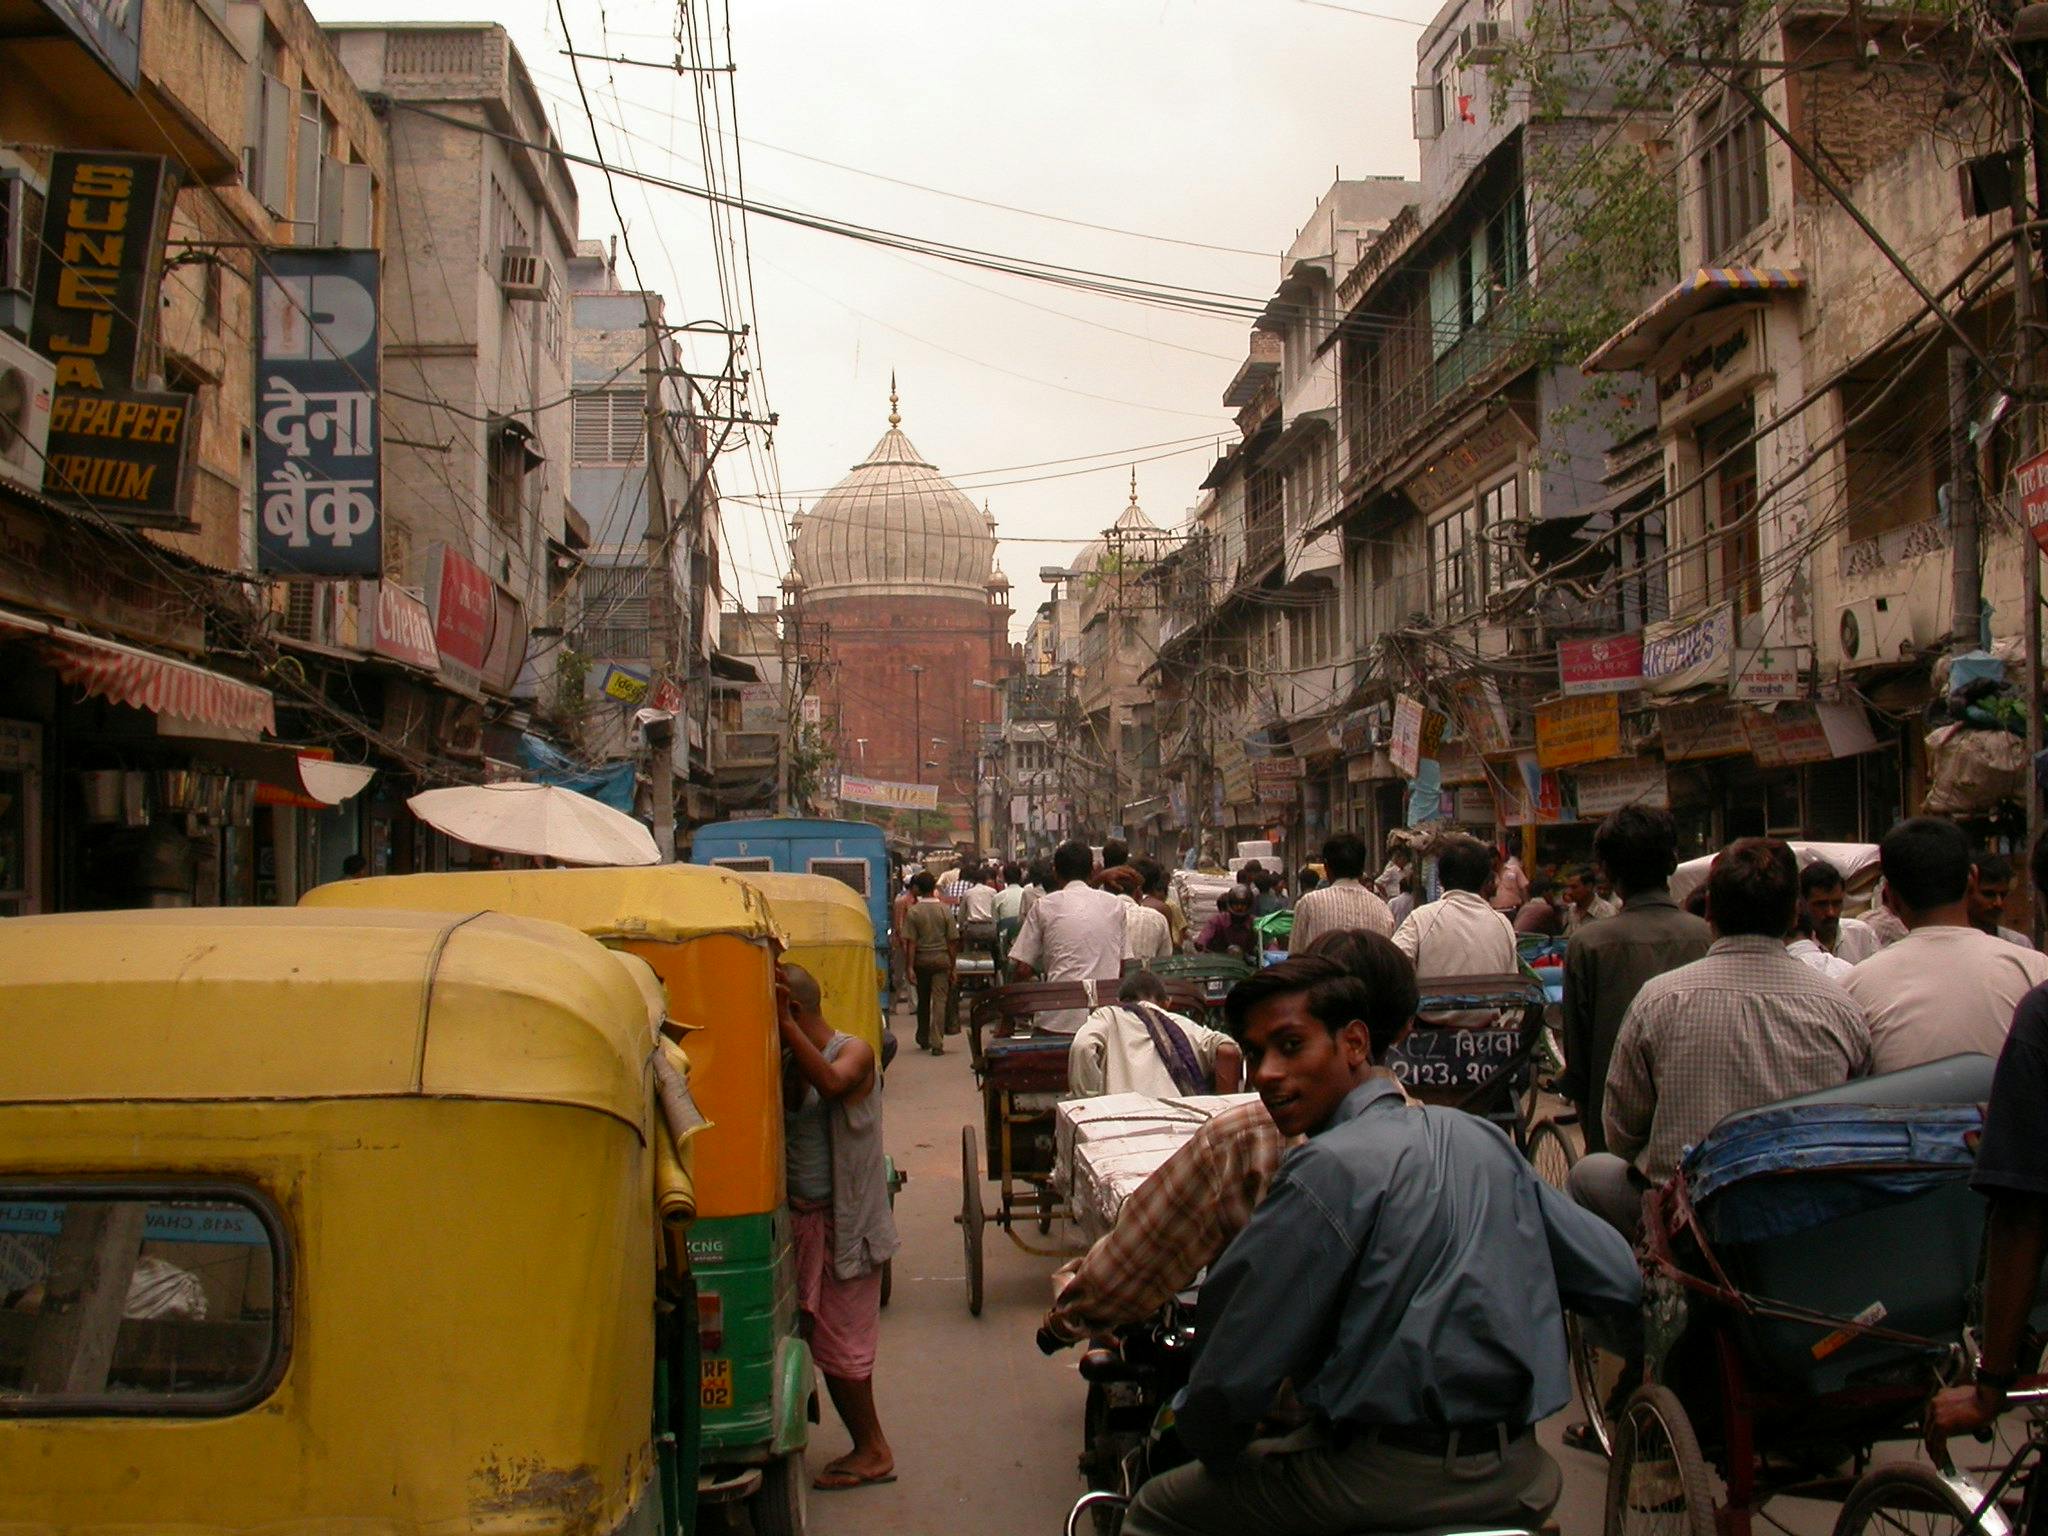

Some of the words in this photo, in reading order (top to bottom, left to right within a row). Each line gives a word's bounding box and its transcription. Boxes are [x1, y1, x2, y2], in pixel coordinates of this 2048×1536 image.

[49, 164, 134, 390] SUNEJA
[262, 376, 376, 457] देना
[262, 460, 376, 548] बैंक
